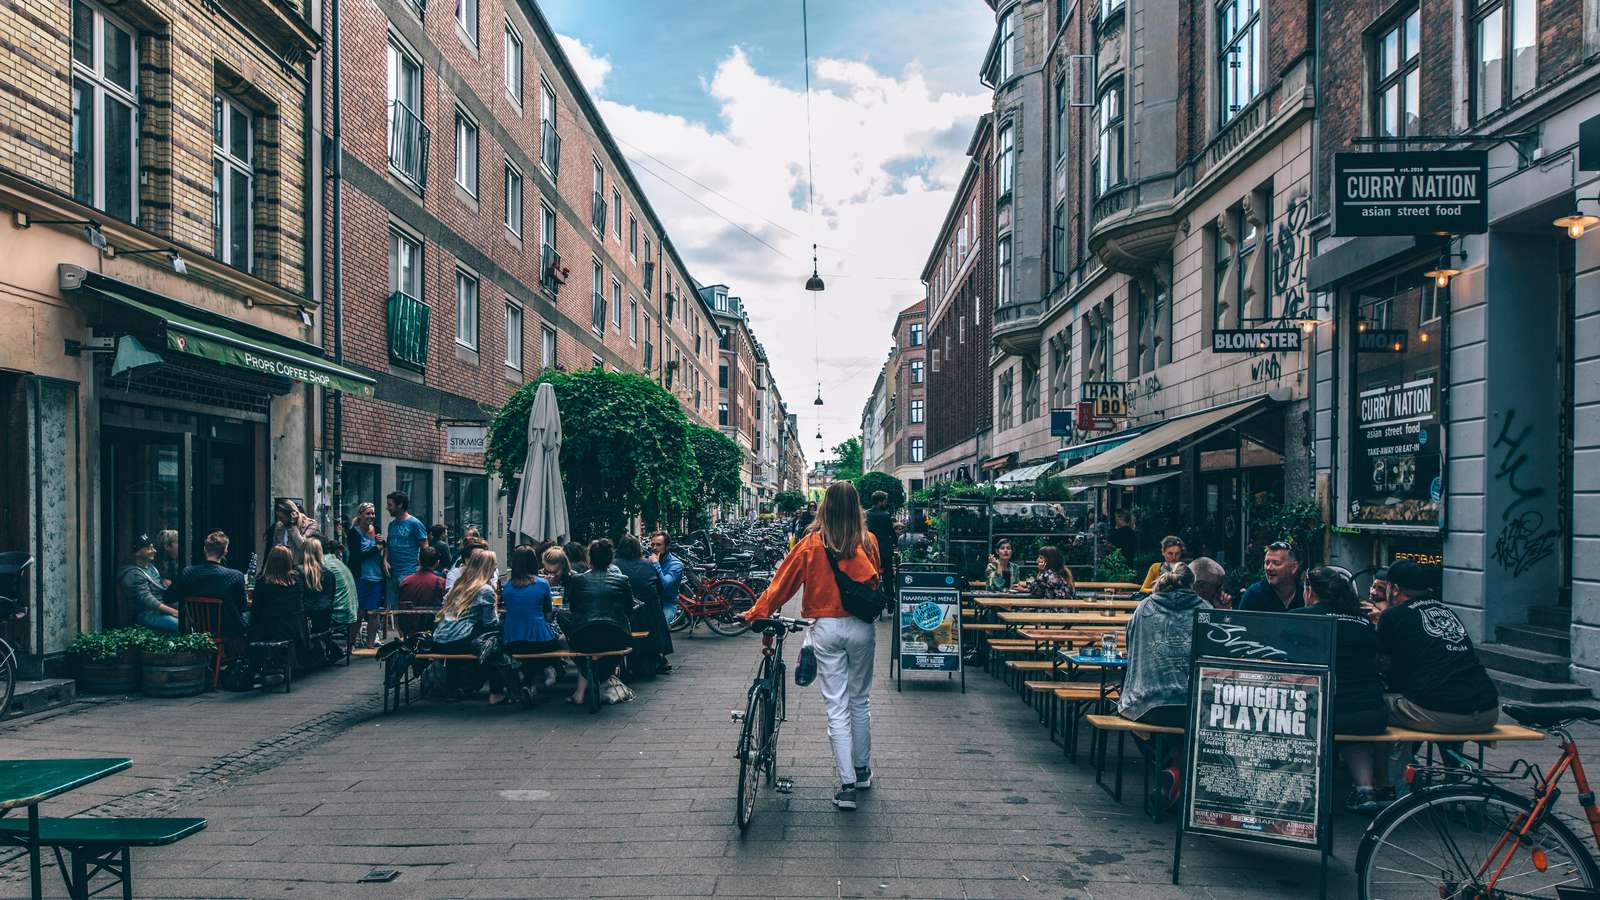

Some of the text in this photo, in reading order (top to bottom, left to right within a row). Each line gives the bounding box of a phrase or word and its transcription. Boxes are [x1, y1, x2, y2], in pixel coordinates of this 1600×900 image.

[1347, 174, 1476, 198] CURRY NATION
[1362, 205, 1461, 217] asian street food
[1215, 332, 1299, 349] BLOMSTER
[1089, 384, 1119, 398] HAR
[1101, 400, 1120, 413] BO
[1361, 387, 1431, 422] CURRY NATION
[1366, 422, 1420, 439] asian street food
[1367, 446, 1394, 456] TAKE-AWAY
[1212, 683, 1307, 711] TONIGHT'S
[1210, 704, 1306, 736] PLAYING
